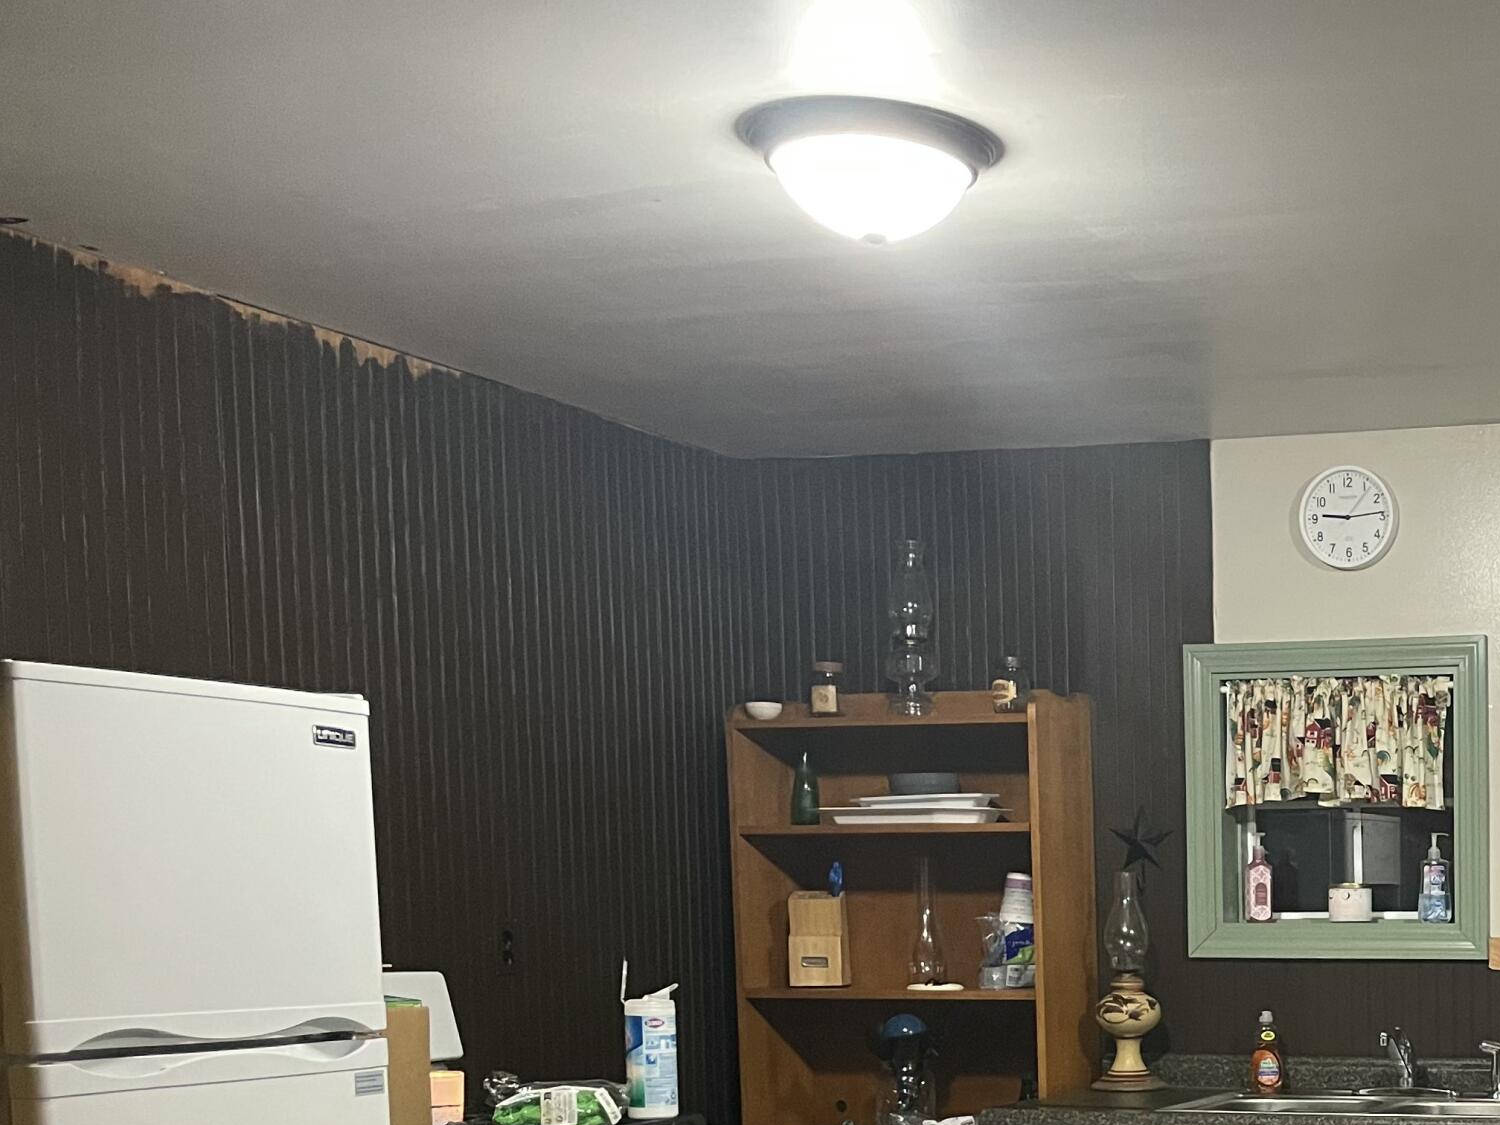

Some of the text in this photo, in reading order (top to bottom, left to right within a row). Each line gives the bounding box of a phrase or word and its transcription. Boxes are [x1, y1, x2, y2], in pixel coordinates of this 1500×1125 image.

[1342, 477, 1353, 488] 12
[1329, 483, 1335, 494] 11
[1316, 496, 1326, 508] 10
[1373, 493, 1380, 504] 2
[1311, 513, 1318, 524] 9
[1379, 511, 1386, 521] 3
[1317, 531, 1323, 542] 8
[1374, 529, 1381, 539] 4
[1329, 543, 1336, 554] 7
[1345, 547, 1352, 558] 6
[1362, 542, 1369, 553] 5
